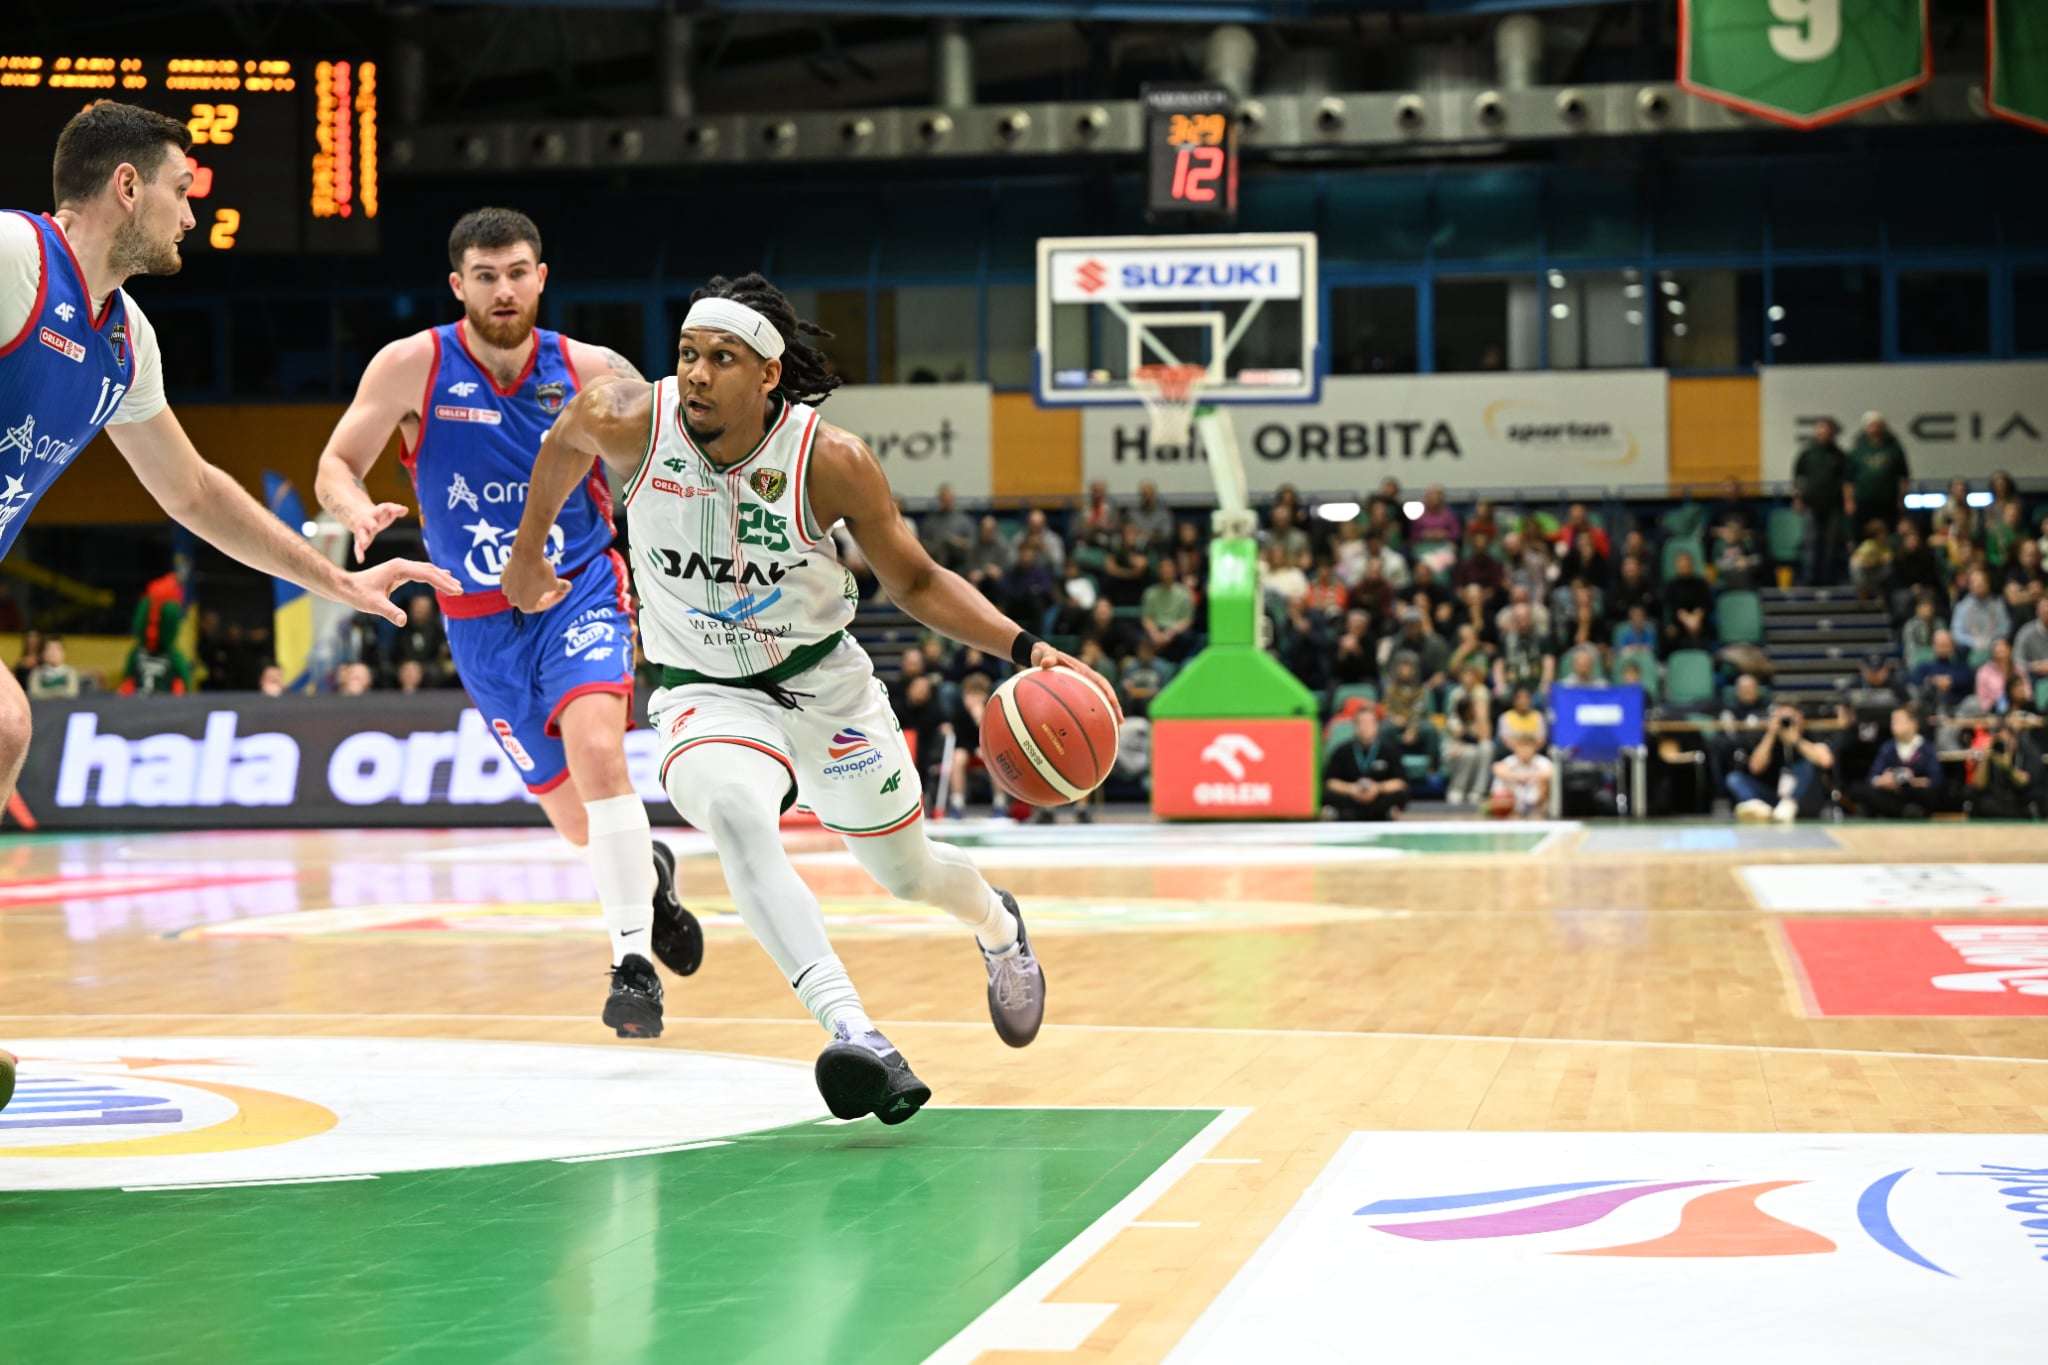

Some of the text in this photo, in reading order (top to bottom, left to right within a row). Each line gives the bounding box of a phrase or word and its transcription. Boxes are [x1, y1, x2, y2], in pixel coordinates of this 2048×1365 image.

[187, 103, 239, 144] 22
[1171, 146, 1226, 202] 12
[210, 208, 240, 249] 2
[1121, 261, 1279, 288] SUZUKI
[54, 302, 76, 322] 4F
[448, 381, 479, 397] 4F
[1113, 420, 1463, 463] Hal ORBITA
[663, 457, 688, 474] 4F
[736, 502, 791, 552] 25
[56, 711, 300, 807] hala
[823, 750, 883, 774] aquapark
[879, 769, 901, 794] 4F
[1192, 782, 1272, 806] ORLEN
